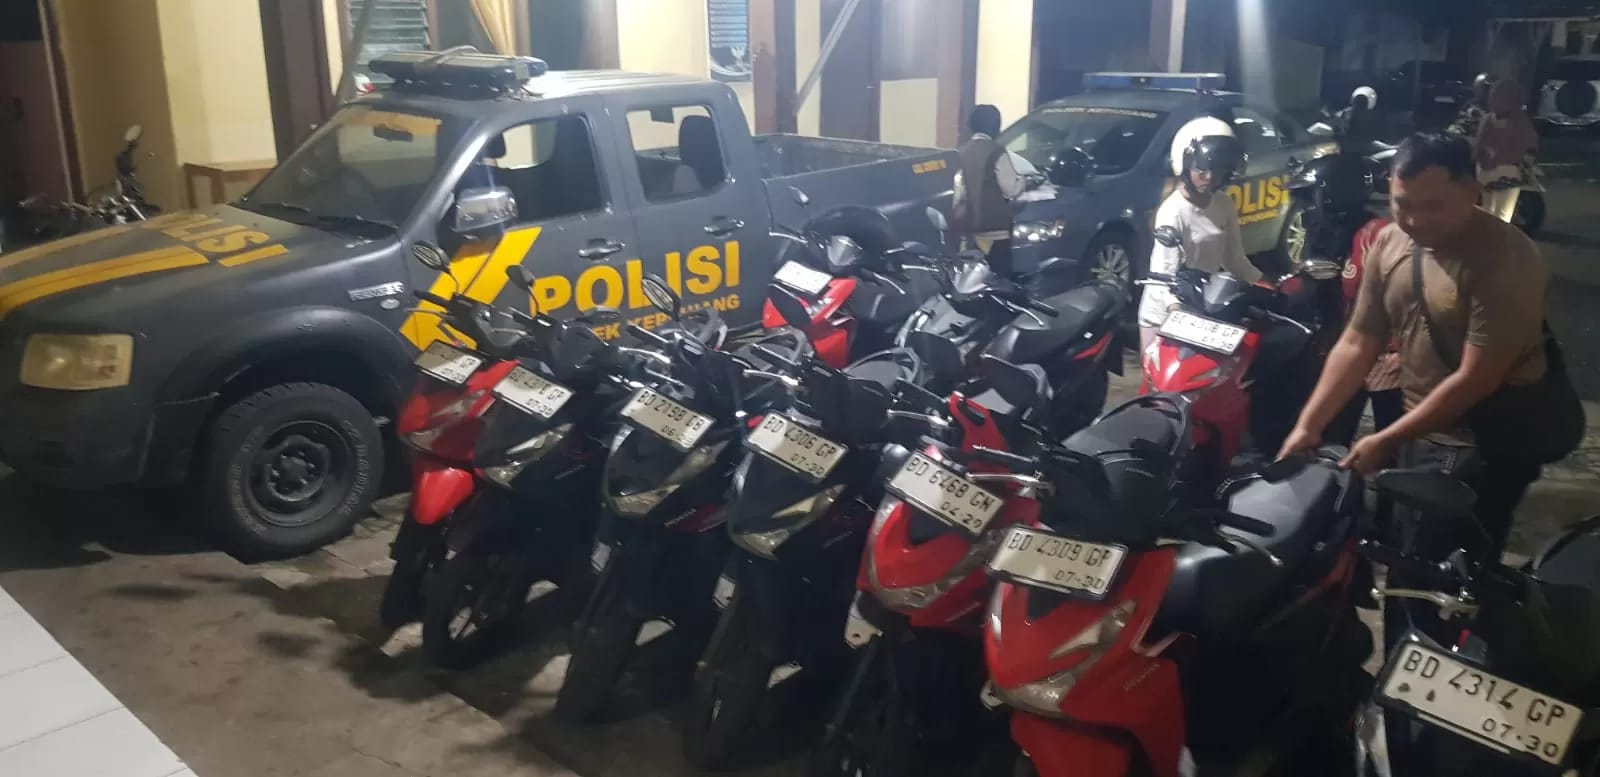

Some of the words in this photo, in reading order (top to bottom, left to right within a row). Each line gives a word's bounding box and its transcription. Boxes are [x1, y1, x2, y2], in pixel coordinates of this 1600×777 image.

[529, 240, 740, 318] POLISI
[637, 390, 657, 406] BD
[764, 416, 785, 433] BD
[784, 427, 817, 449] 4306
[816, 443, 837, 458] GP
[906, 457, 930, 476] BD
[929, 470, 970, 498] 6468
[969, 491, 996, 512] GN
[1008, 532, 1033, 551] BD
[1037, 539, 1083, 561] 4309
[1086, 547, 1112, 567] GP
[1404, 650, 1441, 679] BD
[1448, 668, 1519, 711] 4314
[1526, 698, 1566, 727] GP
